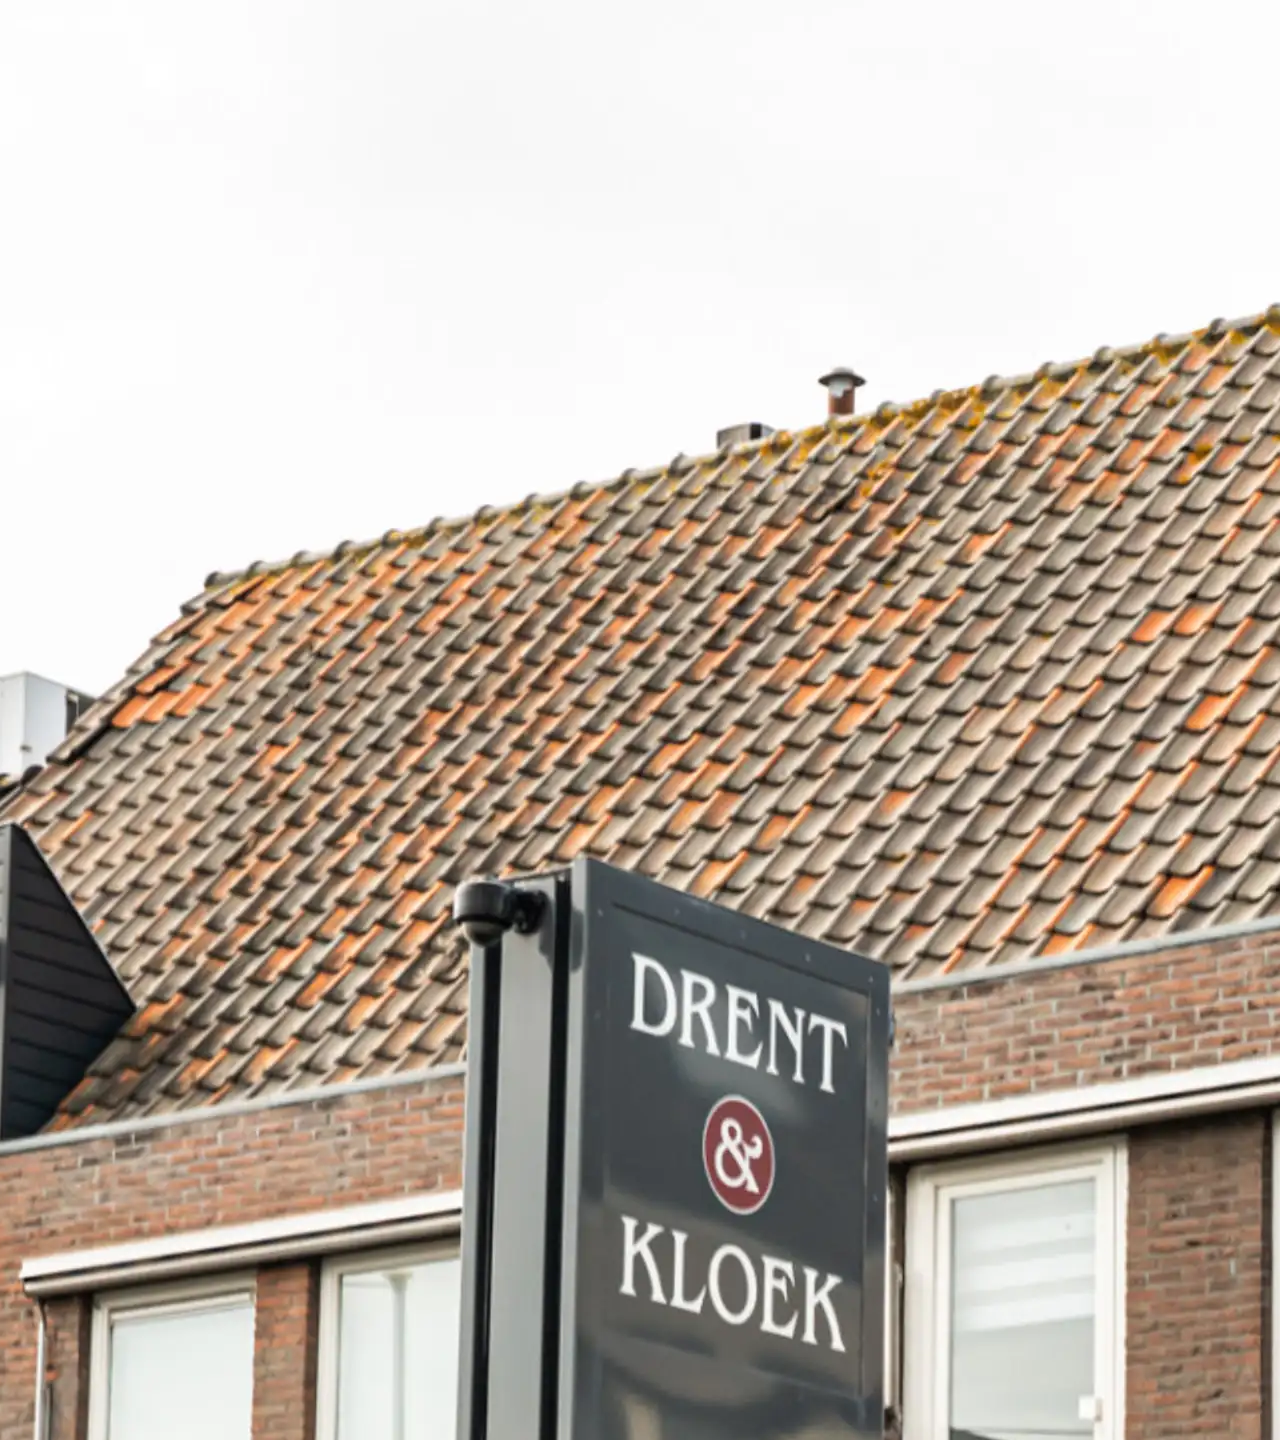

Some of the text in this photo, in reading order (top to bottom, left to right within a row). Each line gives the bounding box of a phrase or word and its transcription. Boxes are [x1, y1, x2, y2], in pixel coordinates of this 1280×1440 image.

[630, 952, 847, 1093] DRENT
[715, 1118, 763, 1195] &
[620, 1215, 846, 1352] KLOEK
